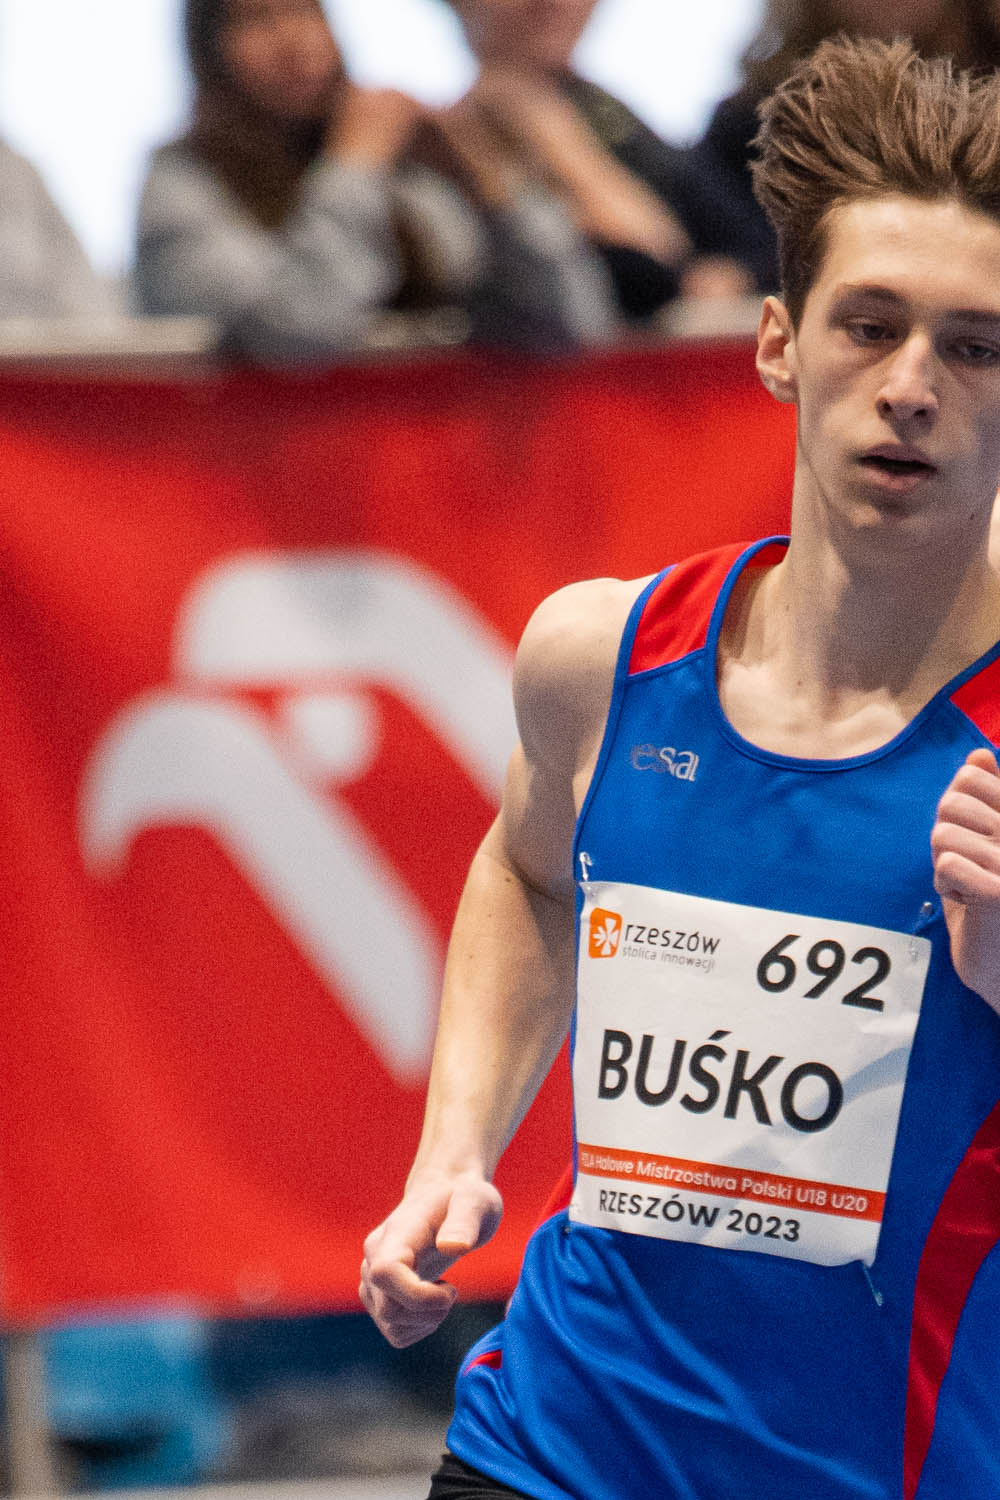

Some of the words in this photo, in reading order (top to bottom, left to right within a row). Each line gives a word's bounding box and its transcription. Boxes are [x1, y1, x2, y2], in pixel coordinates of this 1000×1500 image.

[622, 945, 657, 961] stolica
[660, 950, 715, 974] innowacji
[624, 923, 721, 955] rzeszów
[756, 934, 892, 1013] 692
[597, 1028, 844, 1134] BUŚKO
[636, 1160, 738, 1191] Mistrzostwa
[741, 1177, 793, 1200] Polski
[795, 1187, 828, 1207] U18
[830, 1192, 868, 1213] U20
[599, 1188, 721, 1228] RZESZÓW
[725, 1208, 801, 1243] 2023
